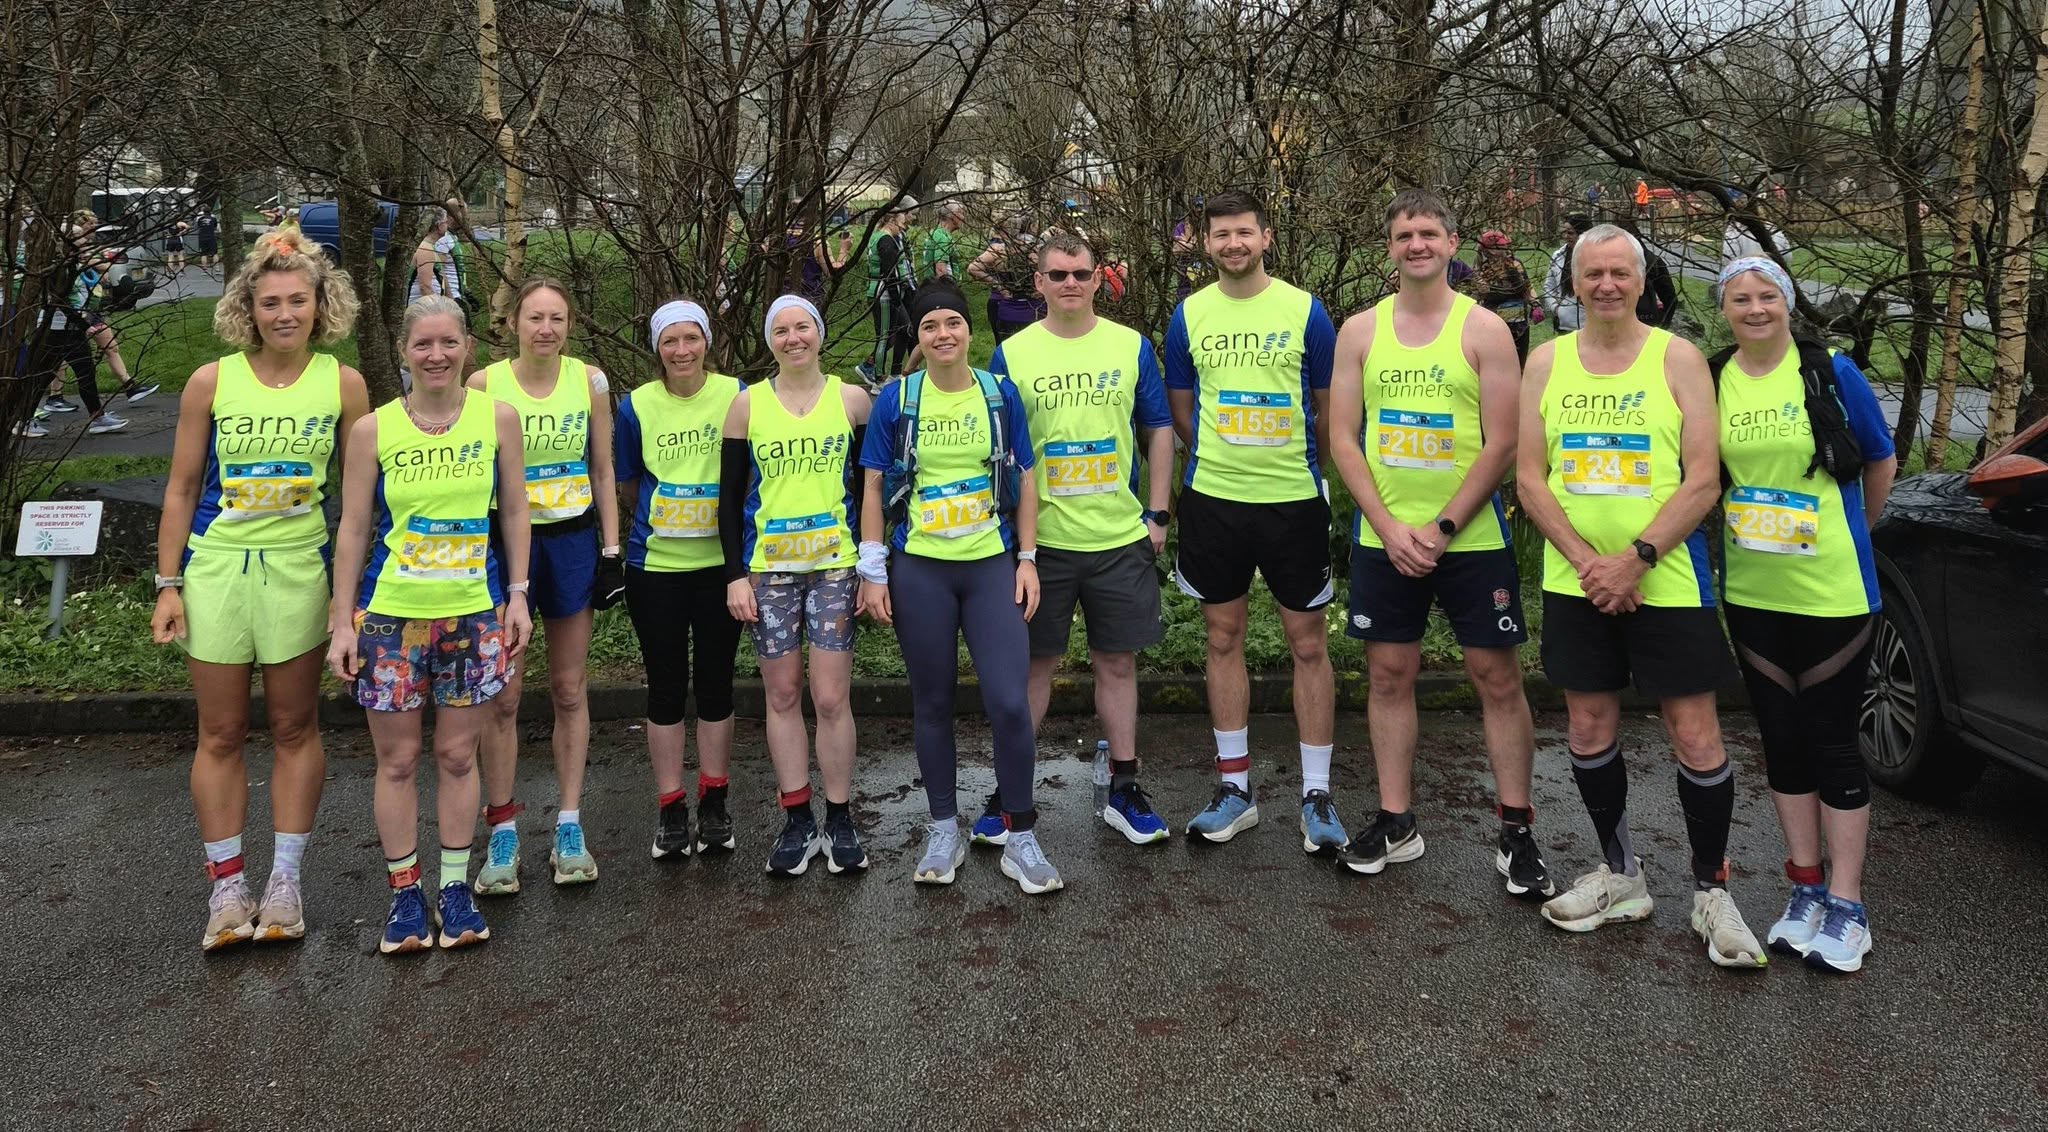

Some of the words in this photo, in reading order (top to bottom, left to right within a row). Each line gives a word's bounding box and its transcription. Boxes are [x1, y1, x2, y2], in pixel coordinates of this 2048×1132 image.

[1201, 332, 1259, 352] carn
[1201, 350, 1293, 369] runners
[1033, 371, 1093, 393] carn
[1379, 369, 1426, 384] carn
[1035, 389, 1123, 412] runners
[1379, 383, 1454, 398] runners
[1561, 394, 1617, 409] carn
[219, 416, 296, 435] carn
[525, 414, 556, 432] rn
[1233, 409, 1277, 434] 155
[1558, 410, 1646, 426] runners
[1729, 408, 1778, 428] carn
[656, 429, 700, 448] carn
[1729, 420, 1812, 443] runners
[217, 437, 333, 456] runners
[757, 437, 817, 462] carn
[1391, 430, 1439, 457] 216
[394, 446, 455, 468] carn
[760, 455, 844, 479] runners
[1586, 453, 1623, 481] 24
[392, 460, 485, 485] runners
[1061, 458, 1103, 483] 221
[533, 481, 578, 506] 176
[665, 502, 712, 525] 250
[937, 498, 980, 526] 179
[1740, 508, 1796, 539] 289
[416, 540, 469, 565] 284
[779, 533, 827, 559] 206
